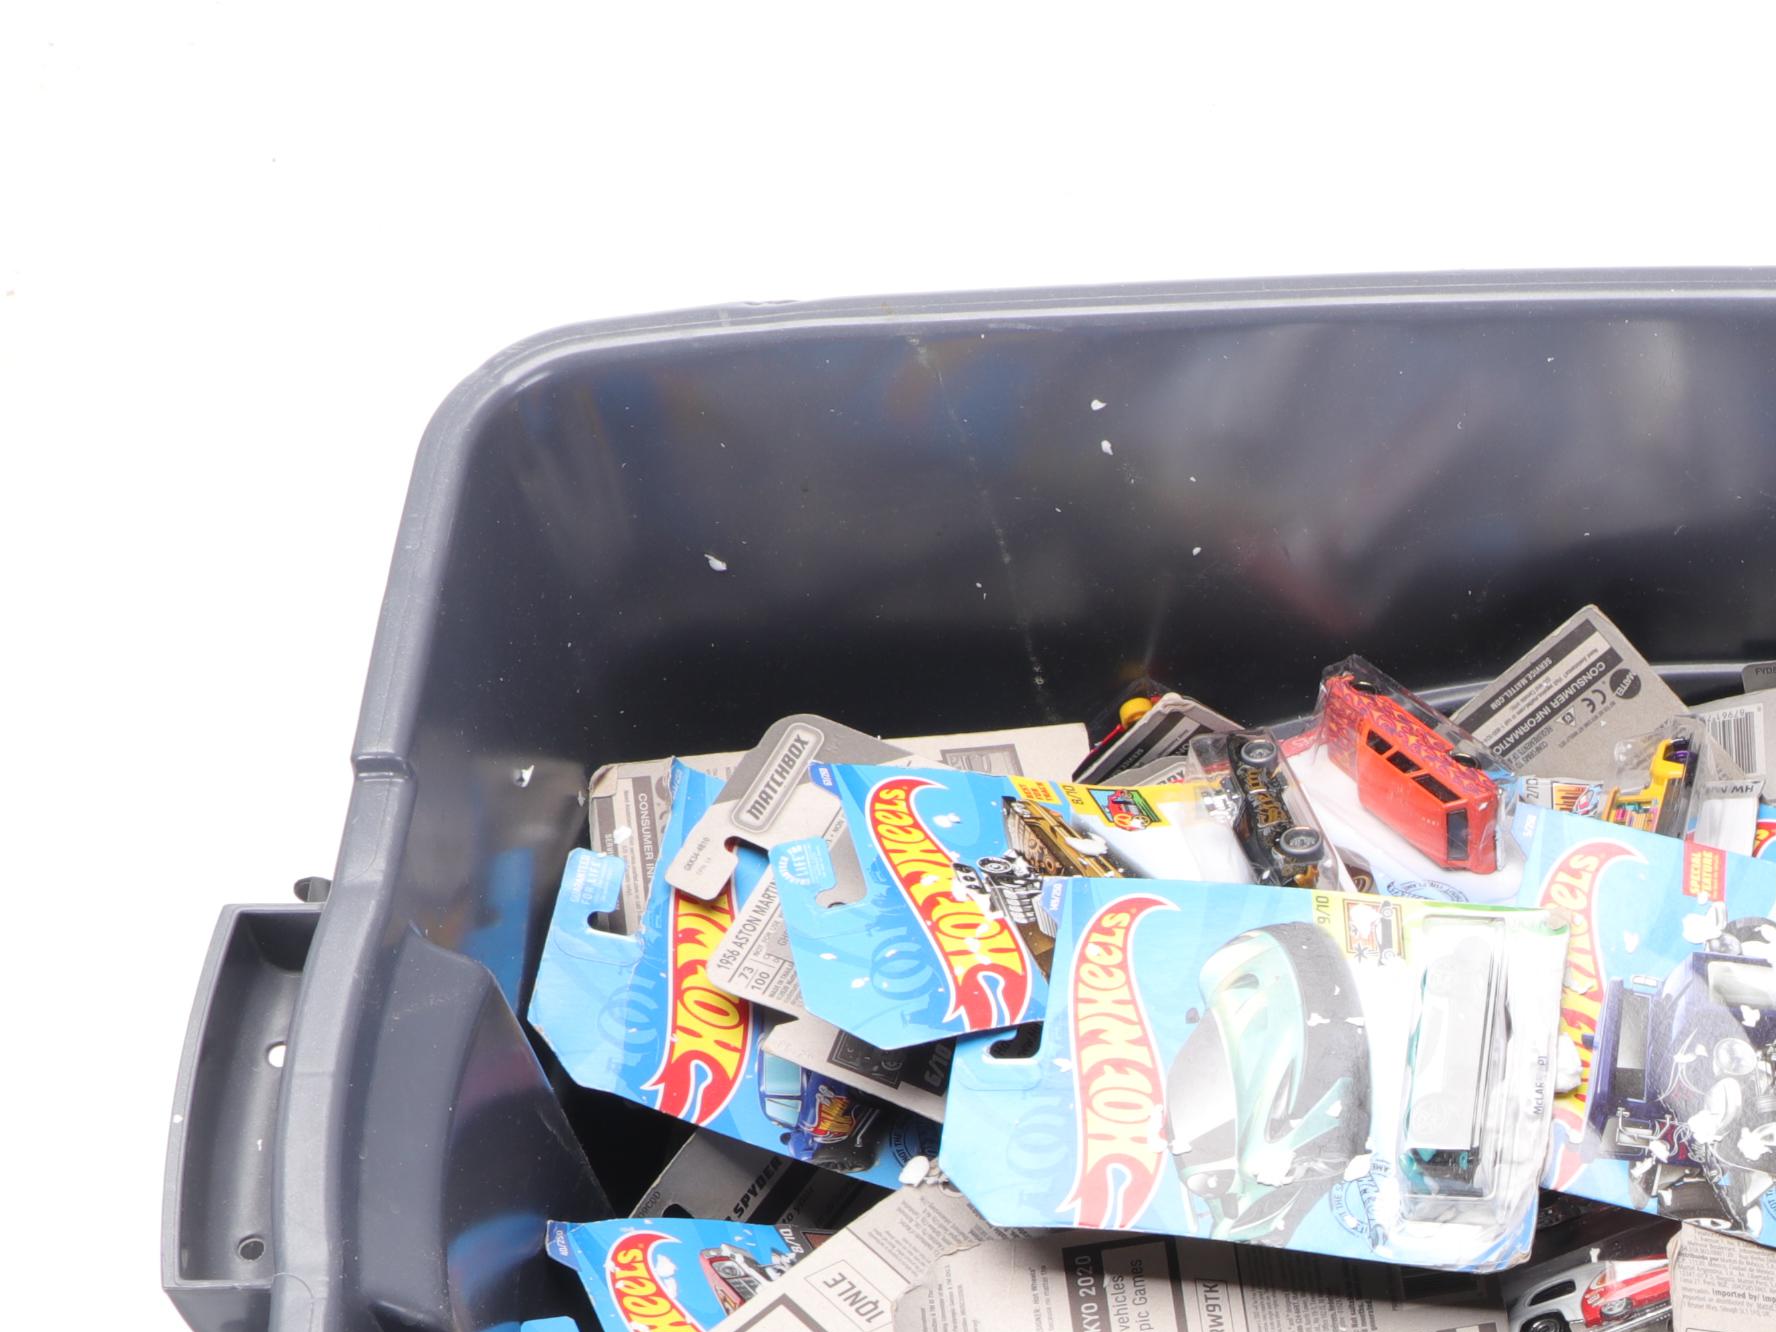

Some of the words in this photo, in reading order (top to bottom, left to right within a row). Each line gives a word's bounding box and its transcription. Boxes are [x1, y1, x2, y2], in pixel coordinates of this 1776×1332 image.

[744, 732, 811, 822] MATCHBOX
[716, 945, 740, 972] 1956
[731, 913, 761, 950] ASTON
[822, 1265, 884, 1326] 1QNLE
[1074, 1254, 1095, 1296] 2020
[1107, 1274, 1130, 1331] vehicles
[1127, 1258, 1147, 1306] Games
